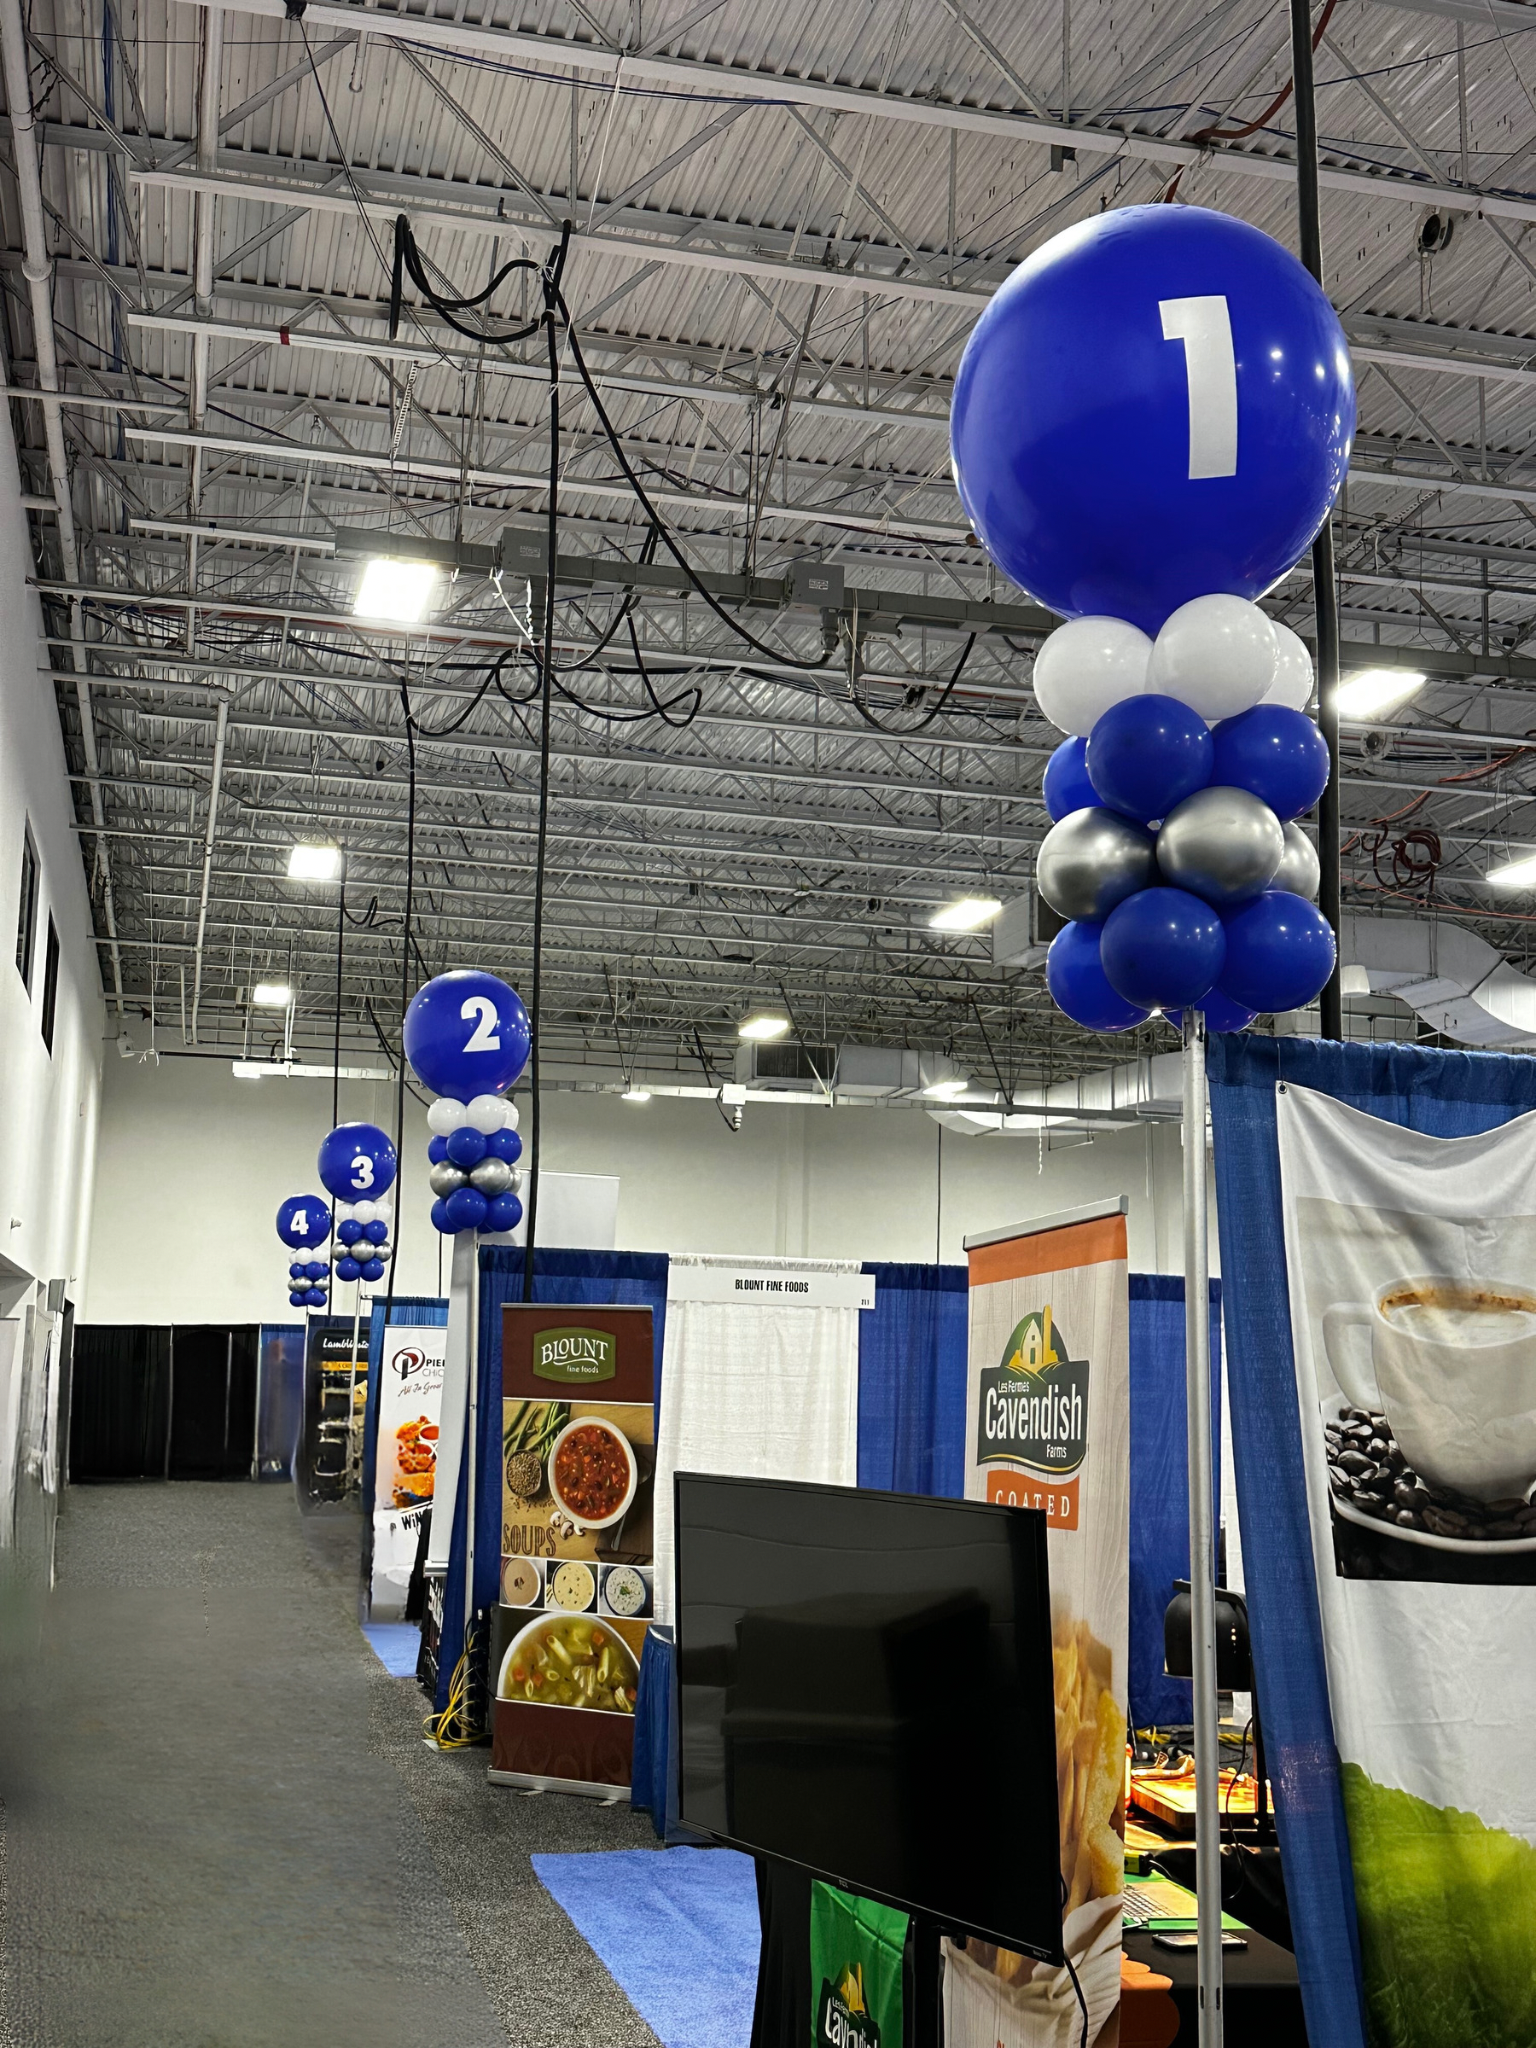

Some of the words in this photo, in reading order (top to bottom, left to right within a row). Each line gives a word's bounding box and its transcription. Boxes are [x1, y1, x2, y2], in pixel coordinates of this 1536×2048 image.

[1158, 295, 1238, 479] 1
[460, 996, 501, 1053] 2
[350, 1155, 374, 1189] 3
[290, 1210, 309, 1236] 4
[735, 1279, 764, 1290] BLOUNT
[766, 1280, 782, 1291] FINE
[784, 1281, 809, 1293] FOODS
[541, 1337, 609, 1366] BLOUNT
[566, 1365, 580, 1373] fine
[581, 1365, 599, 1374] foods
[998, 1381, 1008, 1393] Les
[1008, 1380, 1030, 1393] Fermes
[985, 1383, 1082, 1441] Cavendish
[1046, 1444, 1067, 1458] Farms
[503, 1523, 556, 1557] SOUPS
